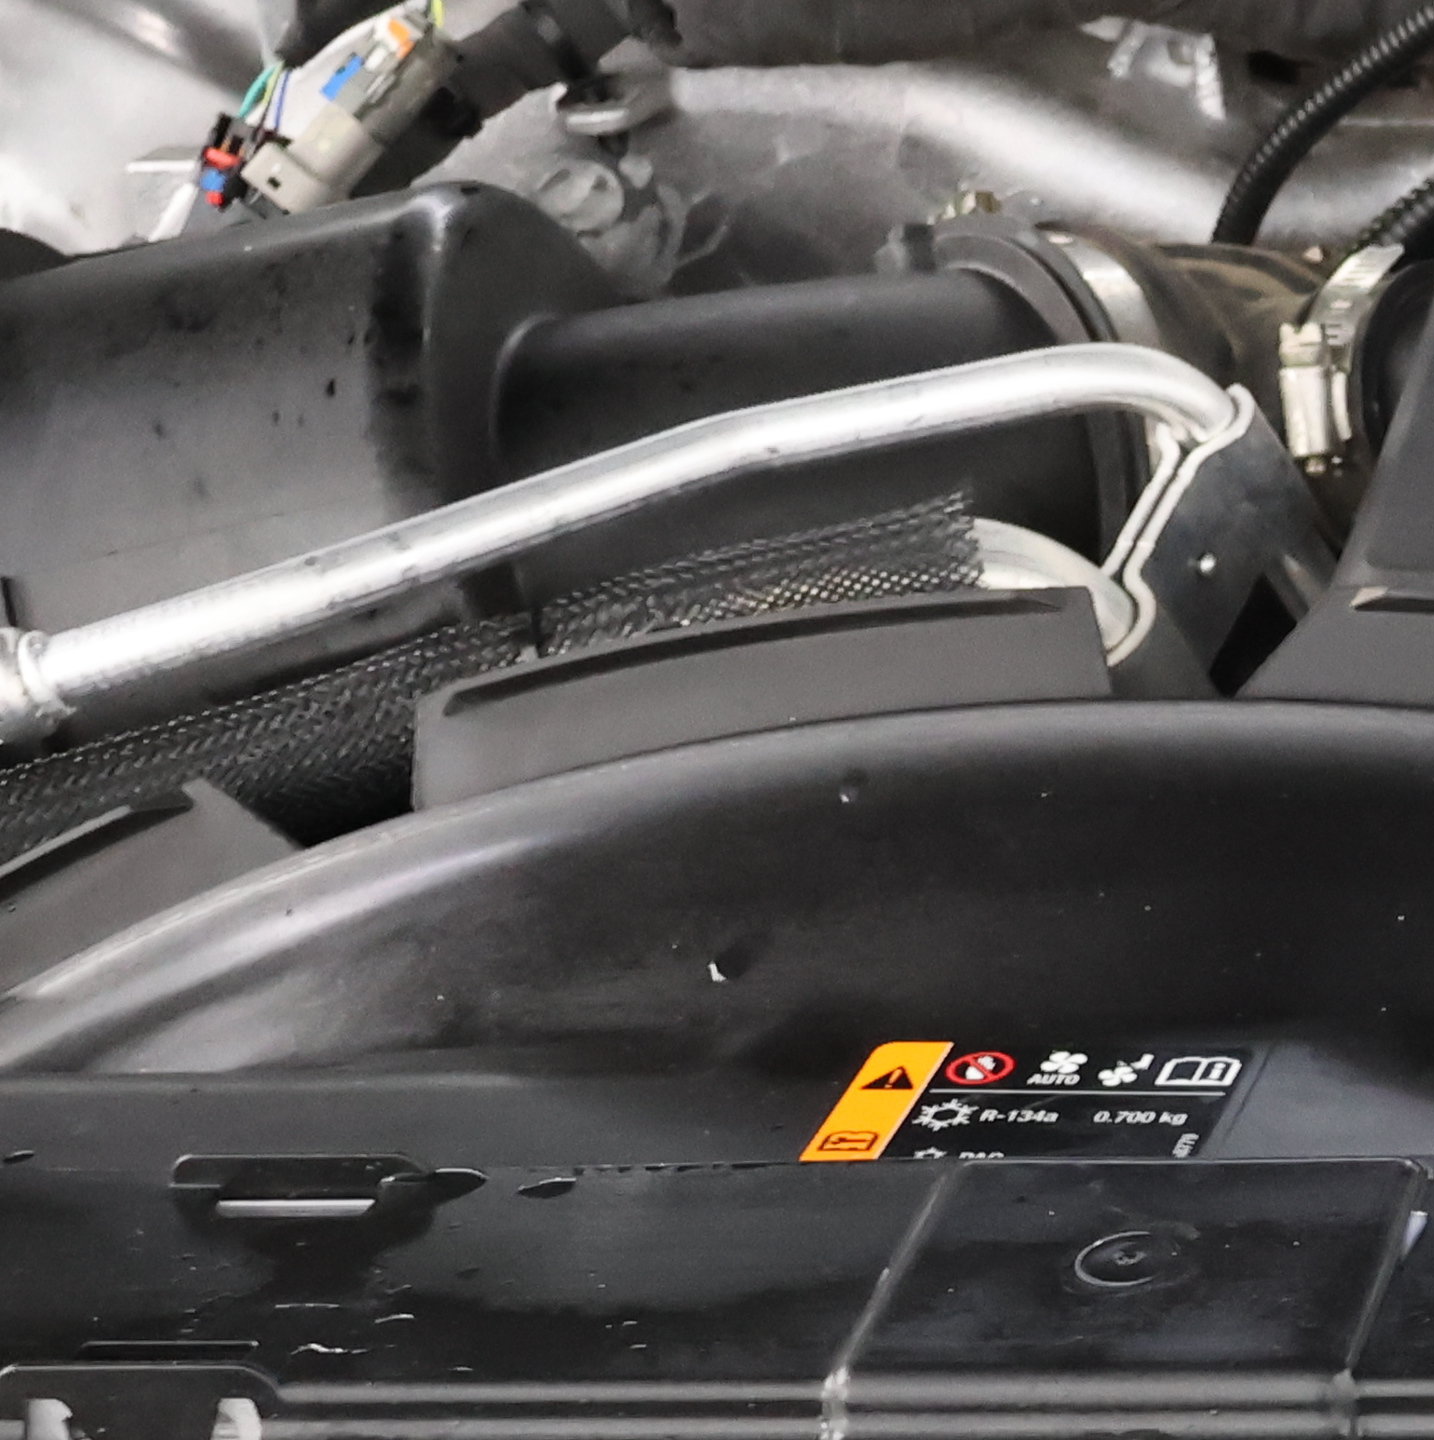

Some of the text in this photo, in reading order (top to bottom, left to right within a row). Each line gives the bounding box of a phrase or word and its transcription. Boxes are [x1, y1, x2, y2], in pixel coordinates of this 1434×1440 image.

[1026, 1073, 1080, 1085] AUTO
[979, 1109, 1188, 1125] R-134a 0.700 kg
